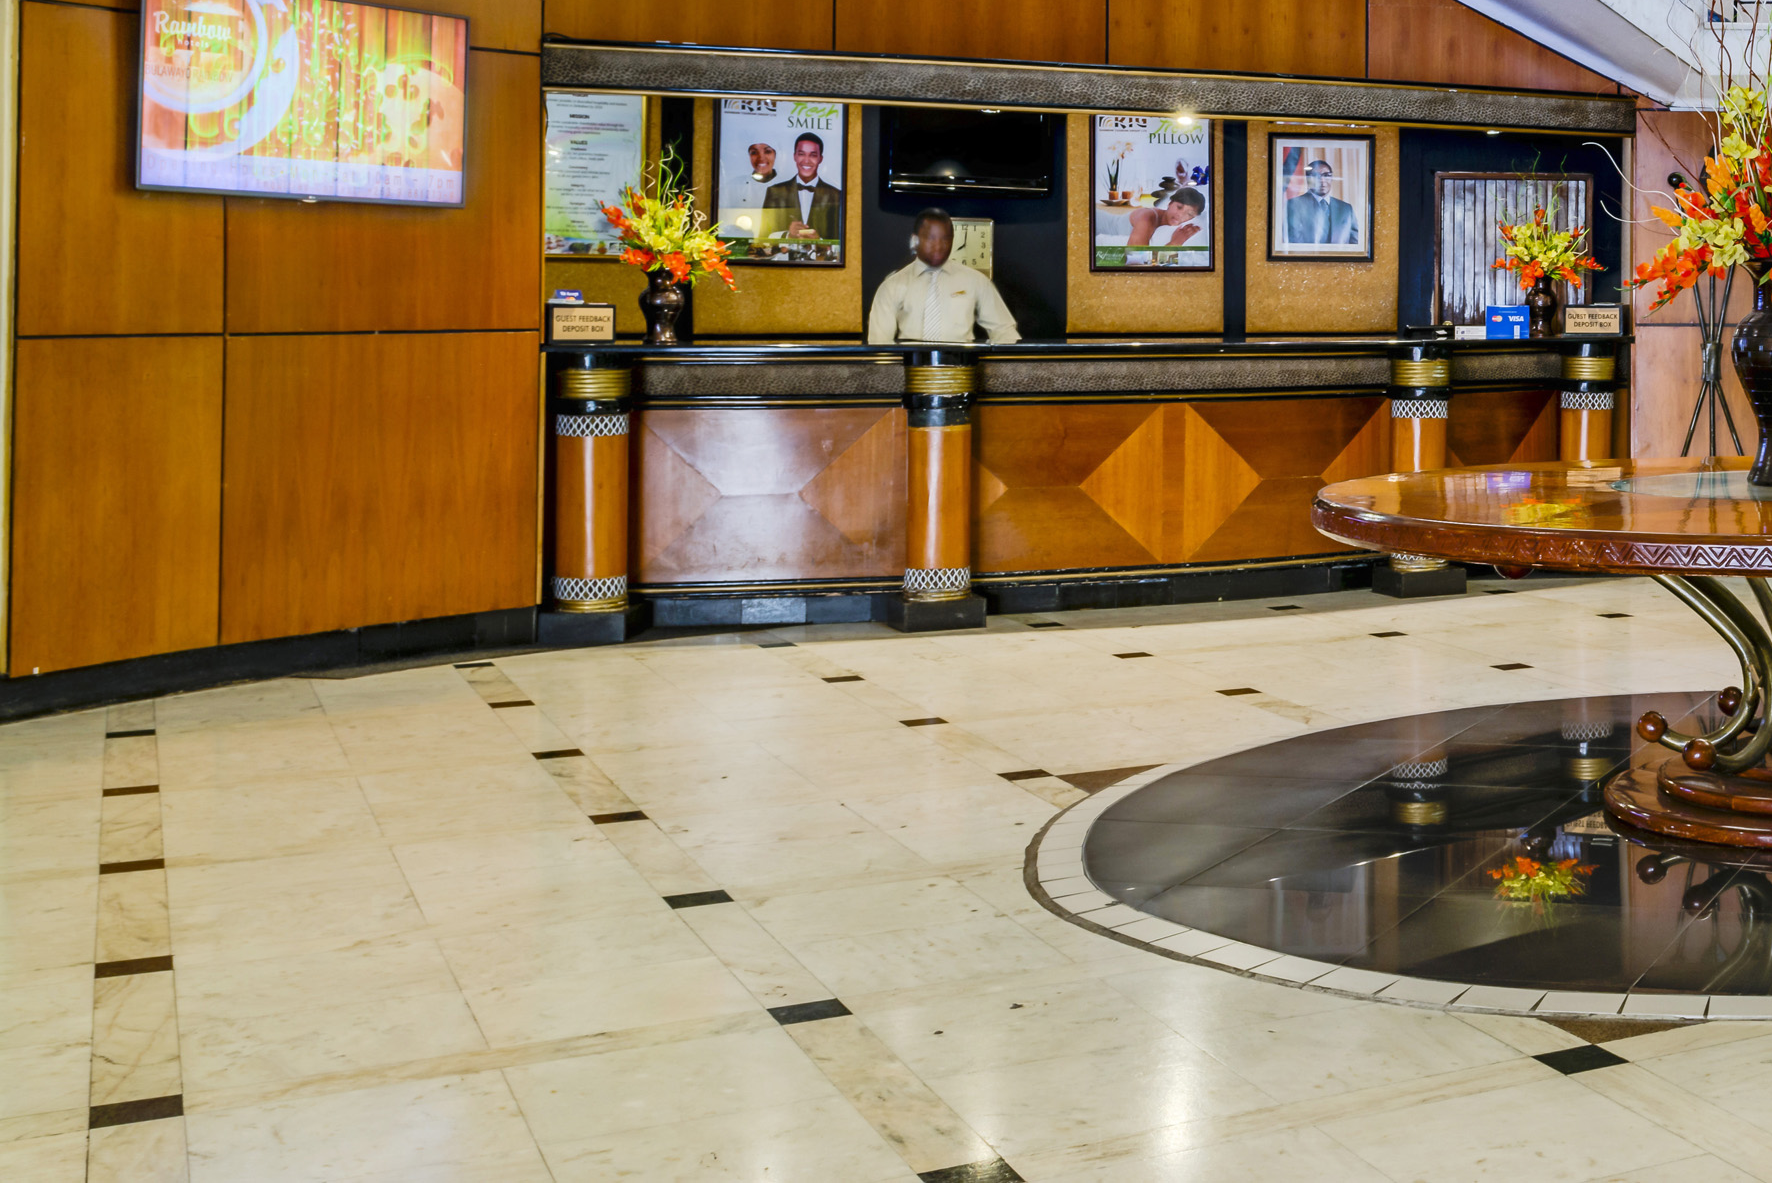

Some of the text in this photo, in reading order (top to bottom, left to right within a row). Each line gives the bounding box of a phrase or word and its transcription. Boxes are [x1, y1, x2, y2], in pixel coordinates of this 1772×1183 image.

[787, 116, 833, 131] SMILE
[1149, 132, 1204, 145] PILLOW
[980, 231, 986, 239] 2
[971, 258, 977, 266] 5
